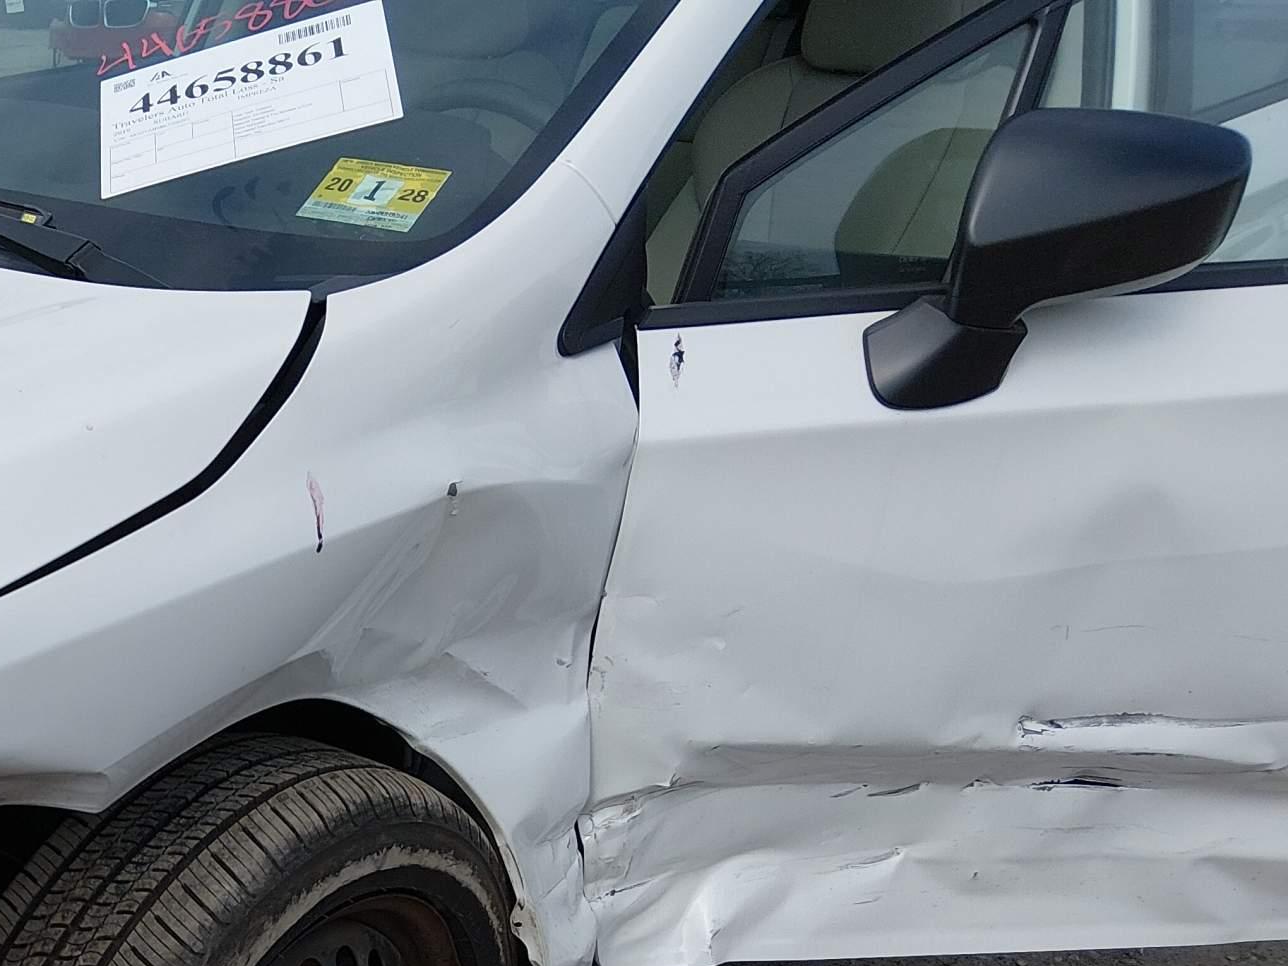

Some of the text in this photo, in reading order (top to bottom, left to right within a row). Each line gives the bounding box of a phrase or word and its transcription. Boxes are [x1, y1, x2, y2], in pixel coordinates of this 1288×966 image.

[129, 37, 348, 113] 44658861
[112, 112, 165, 129] Travelers
[169, 101, 196, 113] Auto
[200, 90, 228, 104] Total
[232, 84, 258, 95] Loss
[324, 176, 429, 203] 20 1 28
